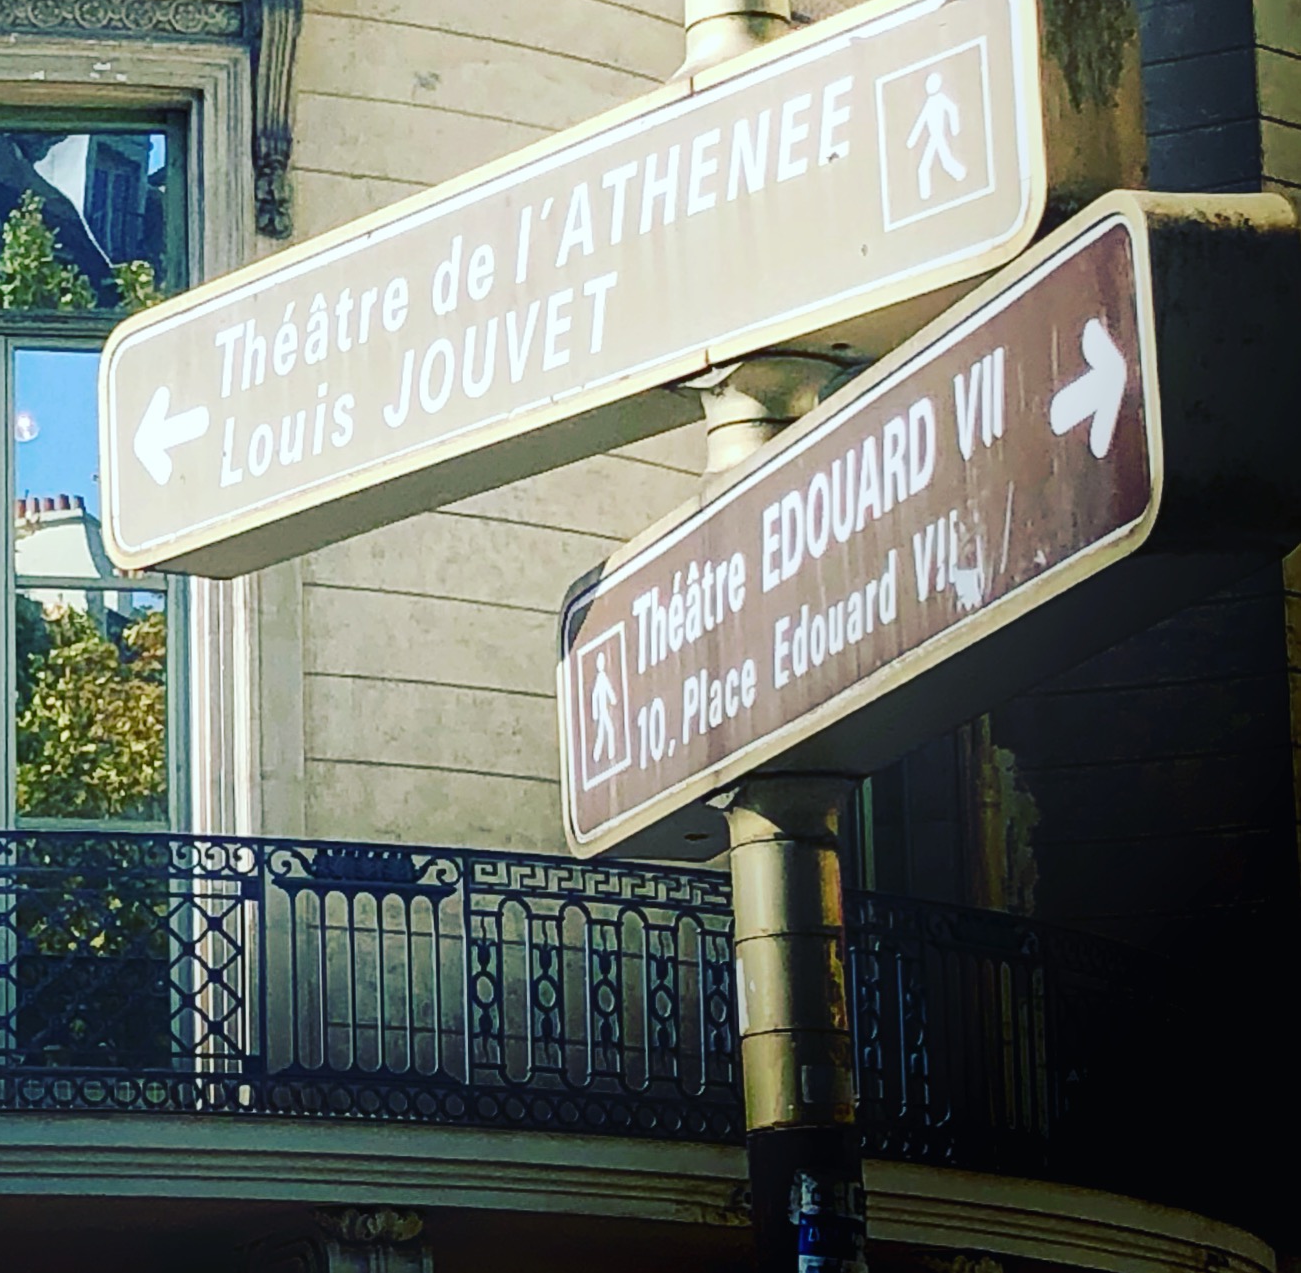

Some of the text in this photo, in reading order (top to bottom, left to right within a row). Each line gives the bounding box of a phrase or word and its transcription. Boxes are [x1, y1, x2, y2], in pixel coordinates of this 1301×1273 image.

[215, 75, 856, 399] Théâtre de l'ATHENEE
[219, 274, 620, 489] Louis JOUVET
[632, 347, 1005, 675] Théâtre EDOUARD VII
[682, 661, 757, 746] Place
[772, 549, 897, 690] Edouard
